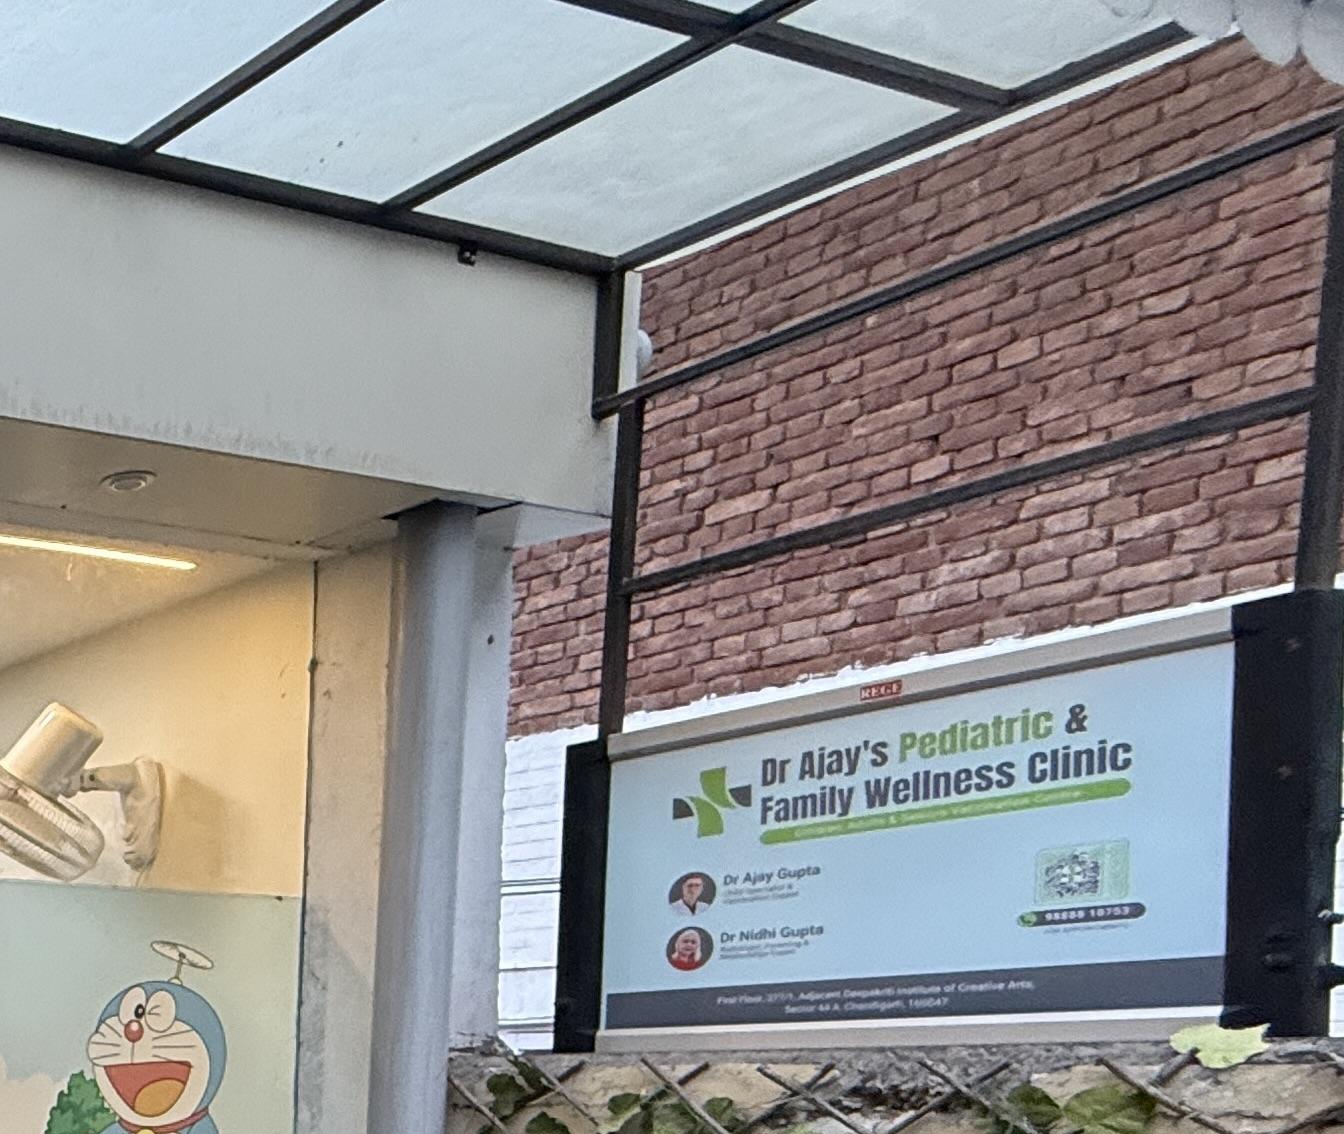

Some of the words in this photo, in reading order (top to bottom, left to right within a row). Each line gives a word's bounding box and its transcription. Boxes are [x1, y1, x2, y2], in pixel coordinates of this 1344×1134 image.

[762, 757, 790, 786] Dr
[799, 740, 888, 782] Ajay's
[899, 708, 1054, 761] Pediatric
[1065, 703, 1088, 734] &
[760, 784, 854, 825] Family
[864, 760, 1016, 809] Wellness
[1027, 739, 1133, 784] Clinic
[724, 874, 739, 886] Dr
[742, 872, 773, 885] Ajay
[777, 866, 821, 880] Gupta
[720, 932, 736, 944] Dr
[739, 928, 776, 942] Nidhi
[780, 925, 824, 940] Gupta
